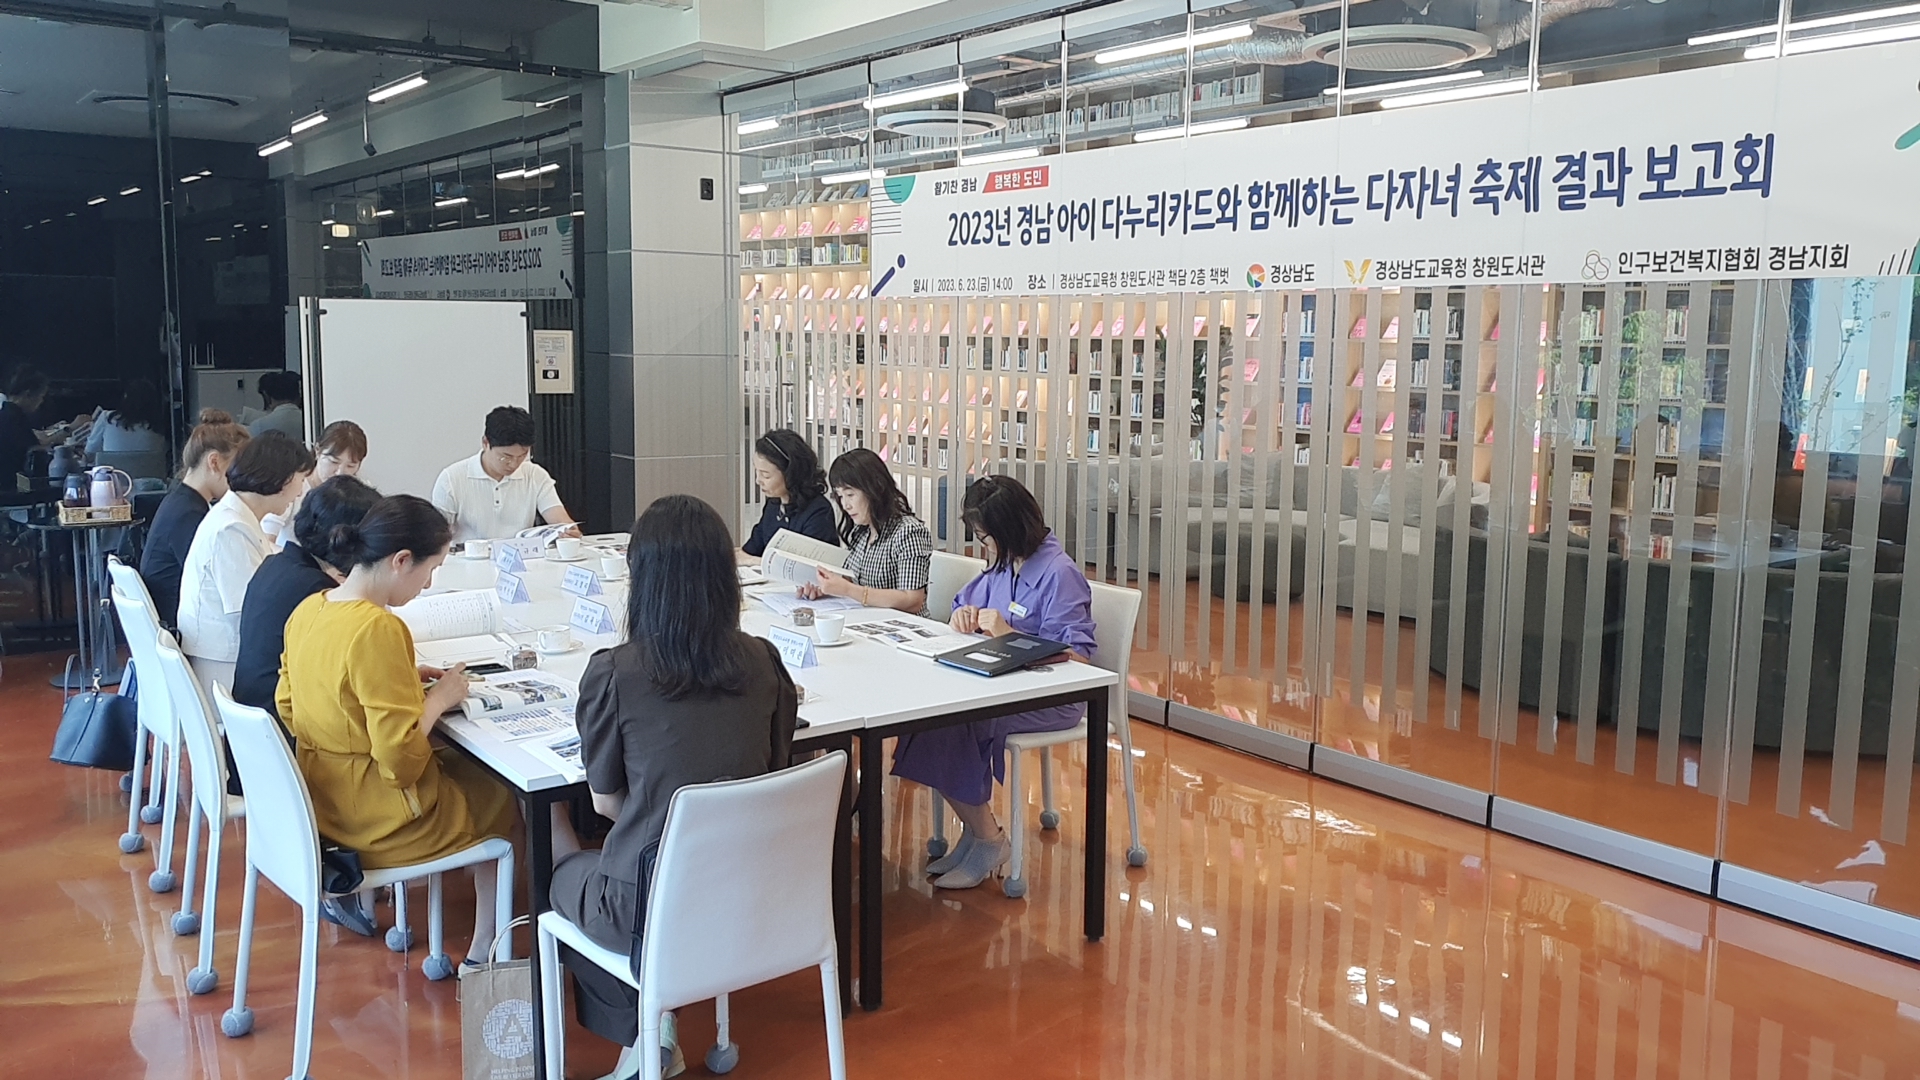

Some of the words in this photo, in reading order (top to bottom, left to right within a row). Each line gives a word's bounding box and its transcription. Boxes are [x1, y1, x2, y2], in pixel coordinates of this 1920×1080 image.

[935, 180, 957, 195] 활기찬
[962, 178, 977, 192] 경남
[995, 173, 1020, 188] 행복한
[1024, 170, 1041, 185] 도민
[948, 206, 1010, 246] 2023년
[1017, 202, 1052, 246] 경남
[1057, 198, 1096, 242] 아이
[1102, 184, 1242, 239] 다누리카드와
[1248, 175, 1359, 230] 함께하는
[1367, 163, 1461, 221] 다자녀
[1469, 156, 1542, 216] 축제
[1552, 147, 1633, 211] 결과
[1638, 133, 1774, 200] 보고회
[1376, 258, 1466, 280] 경상남도교육청
[1473, 255, 1545, 277] 창원도서관
[1619, 247, 1760, 274] 인구보건복지협회
[1769, 244, 1849, 270] 경남지회
[1028, 275, 1046, 289] 장소
[1061, 272, 1116, 289] 경상남도교육청
[1121, 270, 1165, 287] 창원도서관
[1169, 270, 1187, 286] 책담
[1191, 269, 1205, 285] 2층
[1210, 268, 1228, 284] 책벗
[1271, 264, 1314, 283] 경상남도
[914, 279, 928, 292] 일시
[938, 279, 956, 291] 2023.
[959, 279, 964, 291] 6.
[967, 277, 989, 291] 23.(금)
[993, 277, 1012, 290] 14:00
